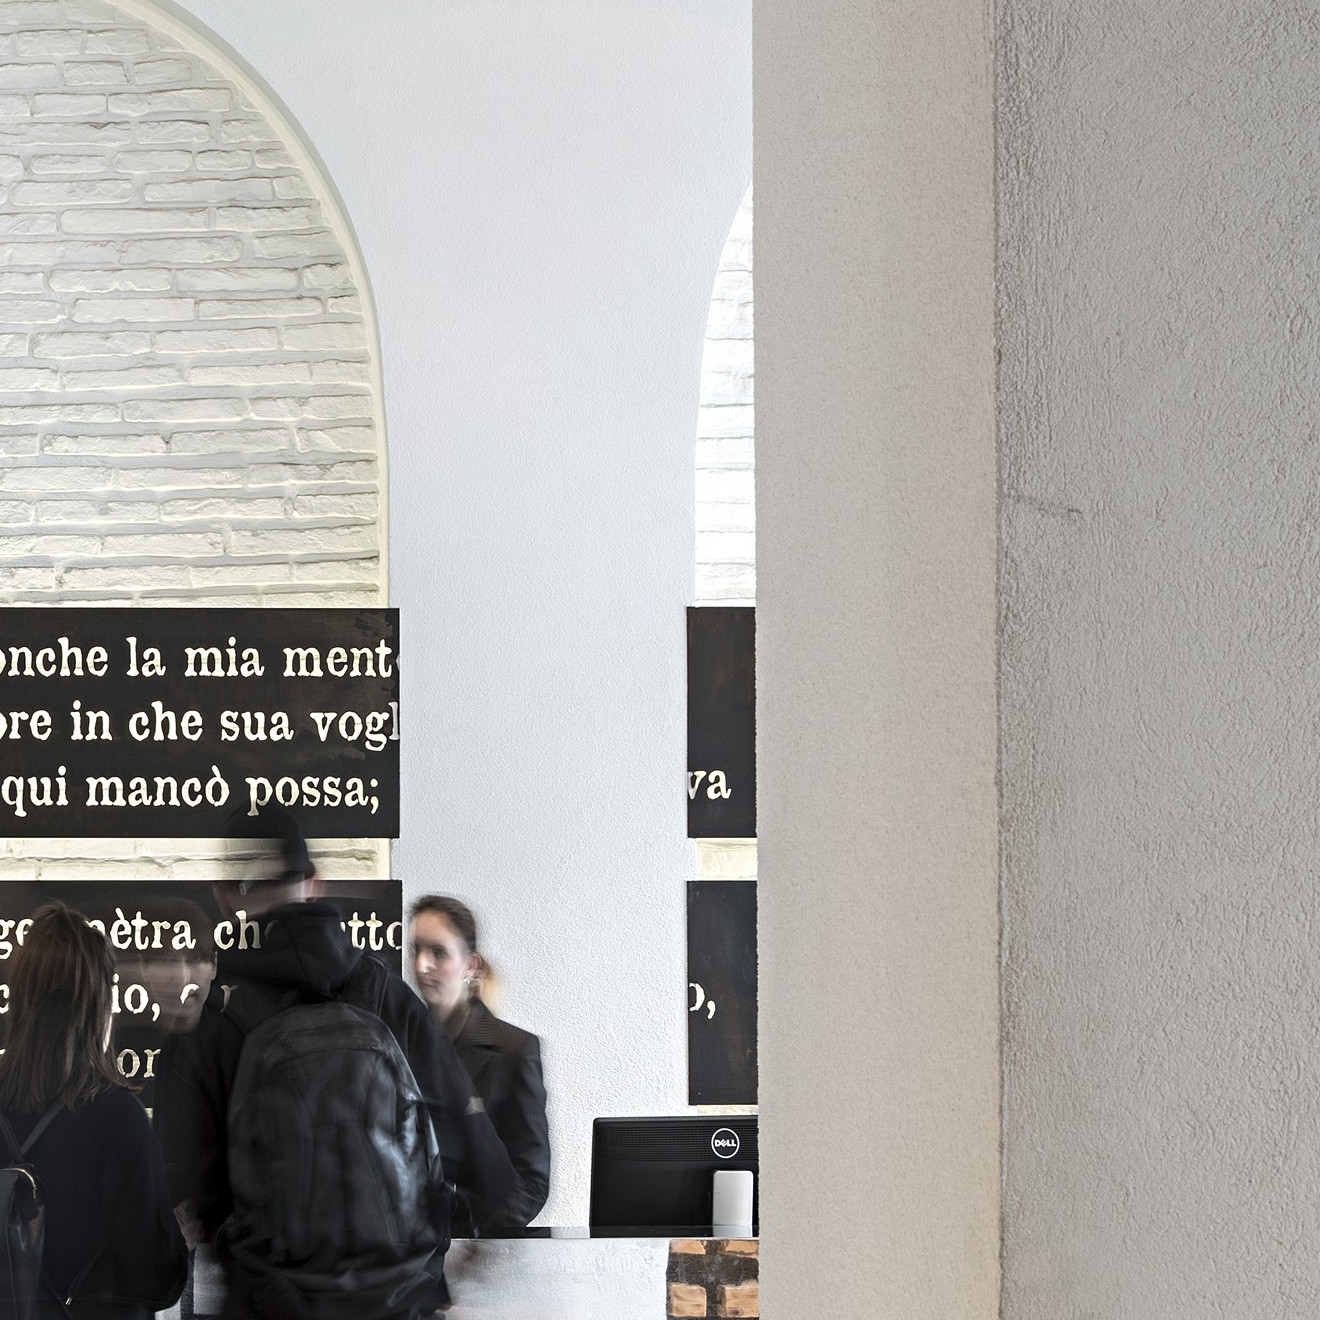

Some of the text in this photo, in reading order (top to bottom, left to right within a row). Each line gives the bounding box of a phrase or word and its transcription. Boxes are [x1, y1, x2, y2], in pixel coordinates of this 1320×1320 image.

[125, 636, 167, 678] la
[184, 636, 265, 678] mia
[282, 638, 400, 679] ment
[69, 699, 113, 741] in
[128, 700, 204, 742] che
[220, 710, 295, 742] sua
[1, 765, 69, 818] qui
[85, 764, 230, 808] mancò
[244, 775, 379, 817] possa;
[714, 1138, 737, 1148] DELL
